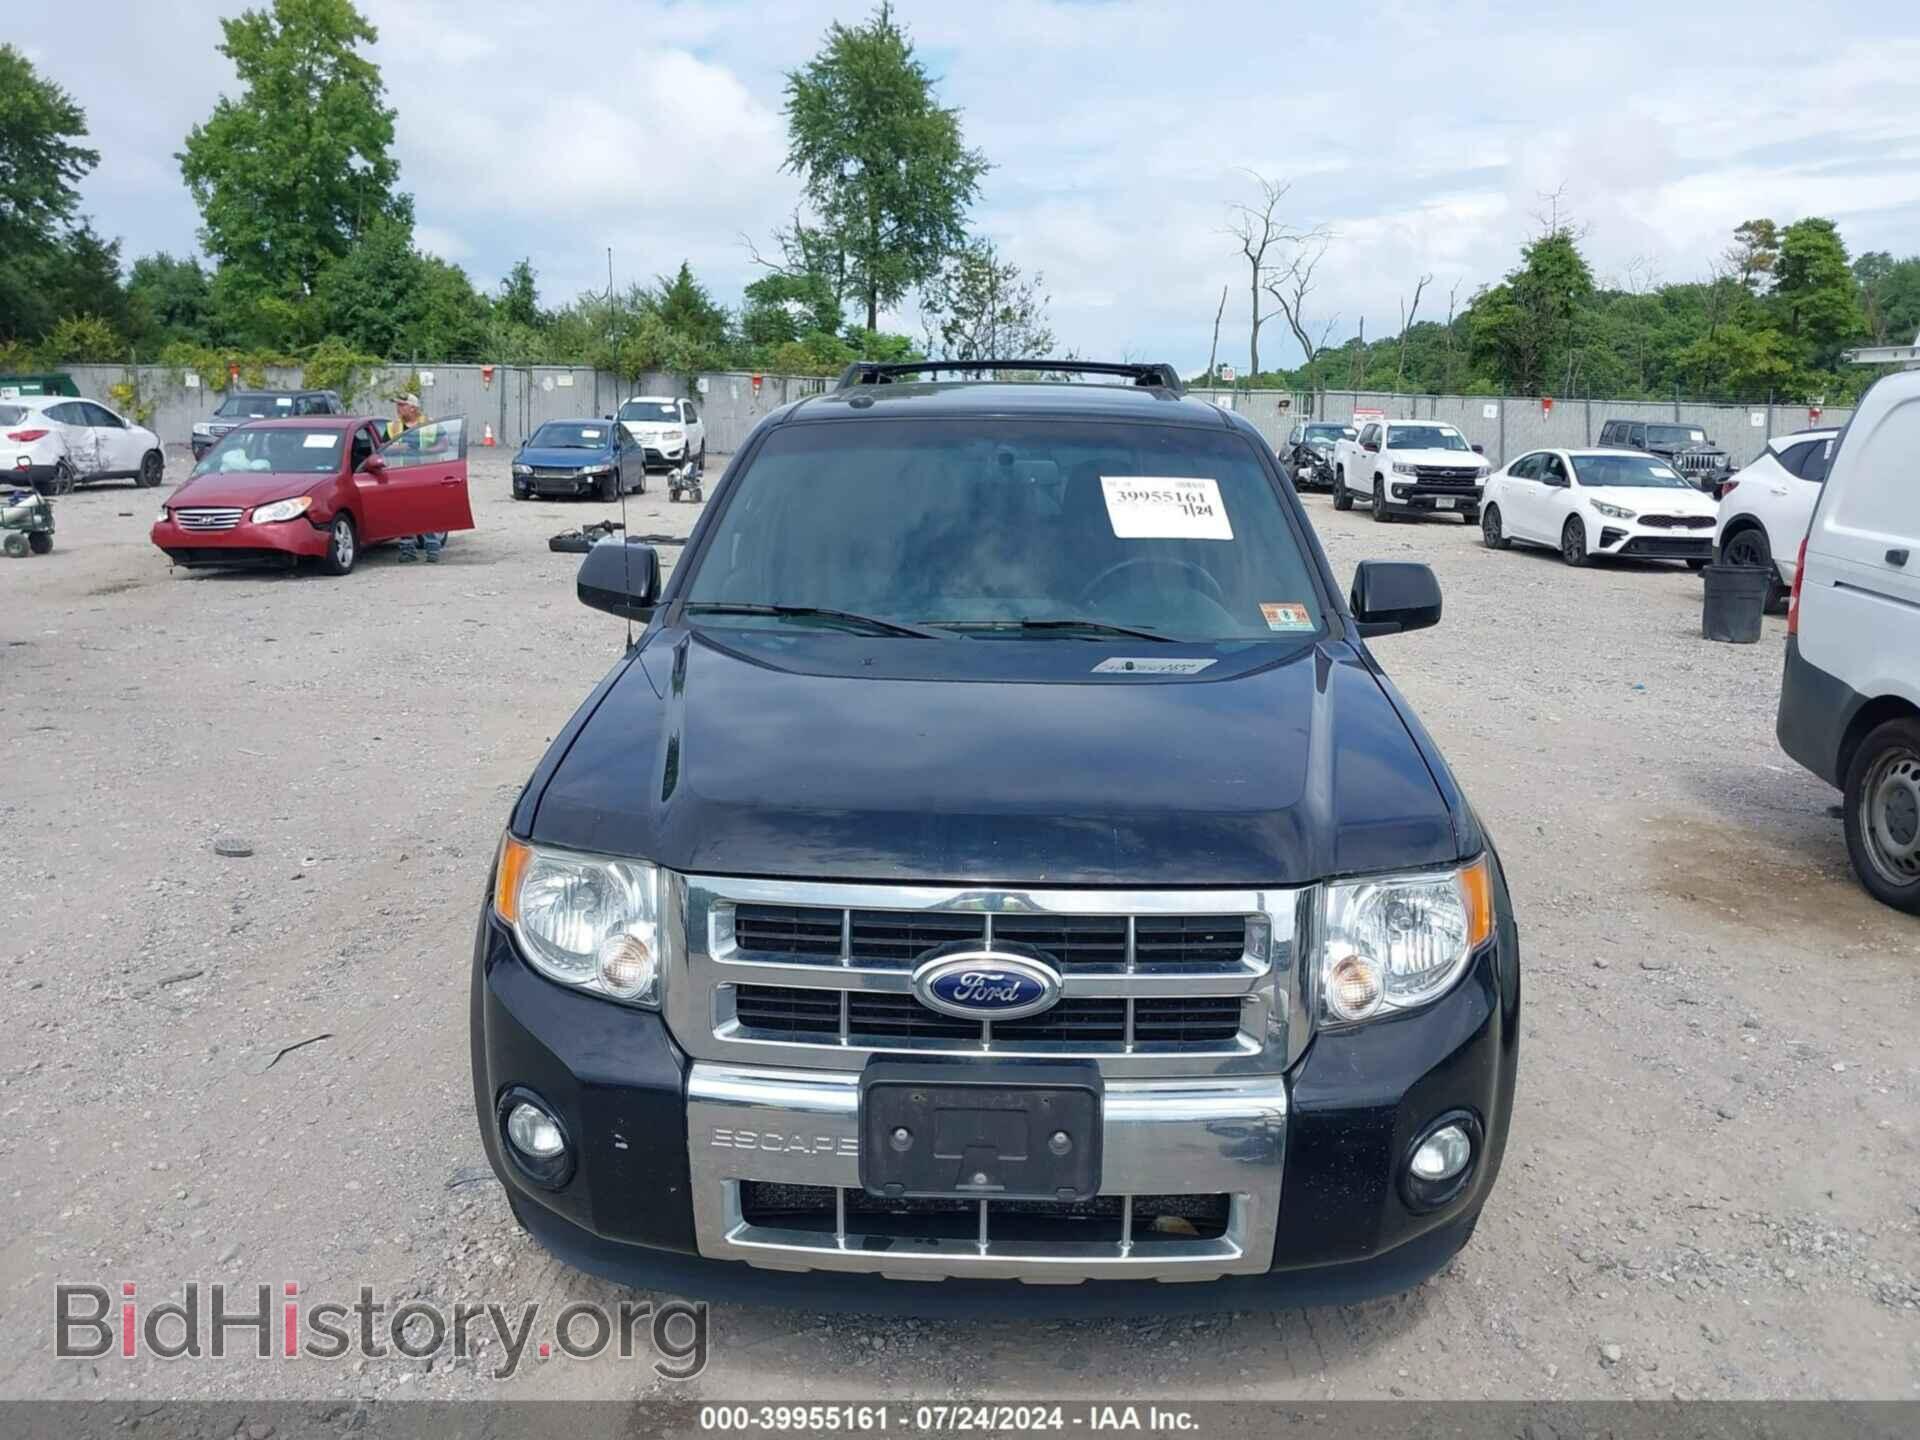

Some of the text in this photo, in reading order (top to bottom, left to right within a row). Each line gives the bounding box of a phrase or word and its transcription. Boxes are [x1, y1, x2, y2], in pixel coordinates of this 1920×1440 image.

[1116, 490, 1206, 503] 39955161
[953, 971, 1022, 1002] Ford
[711, 1128, 859, 1157] ESCAPE
